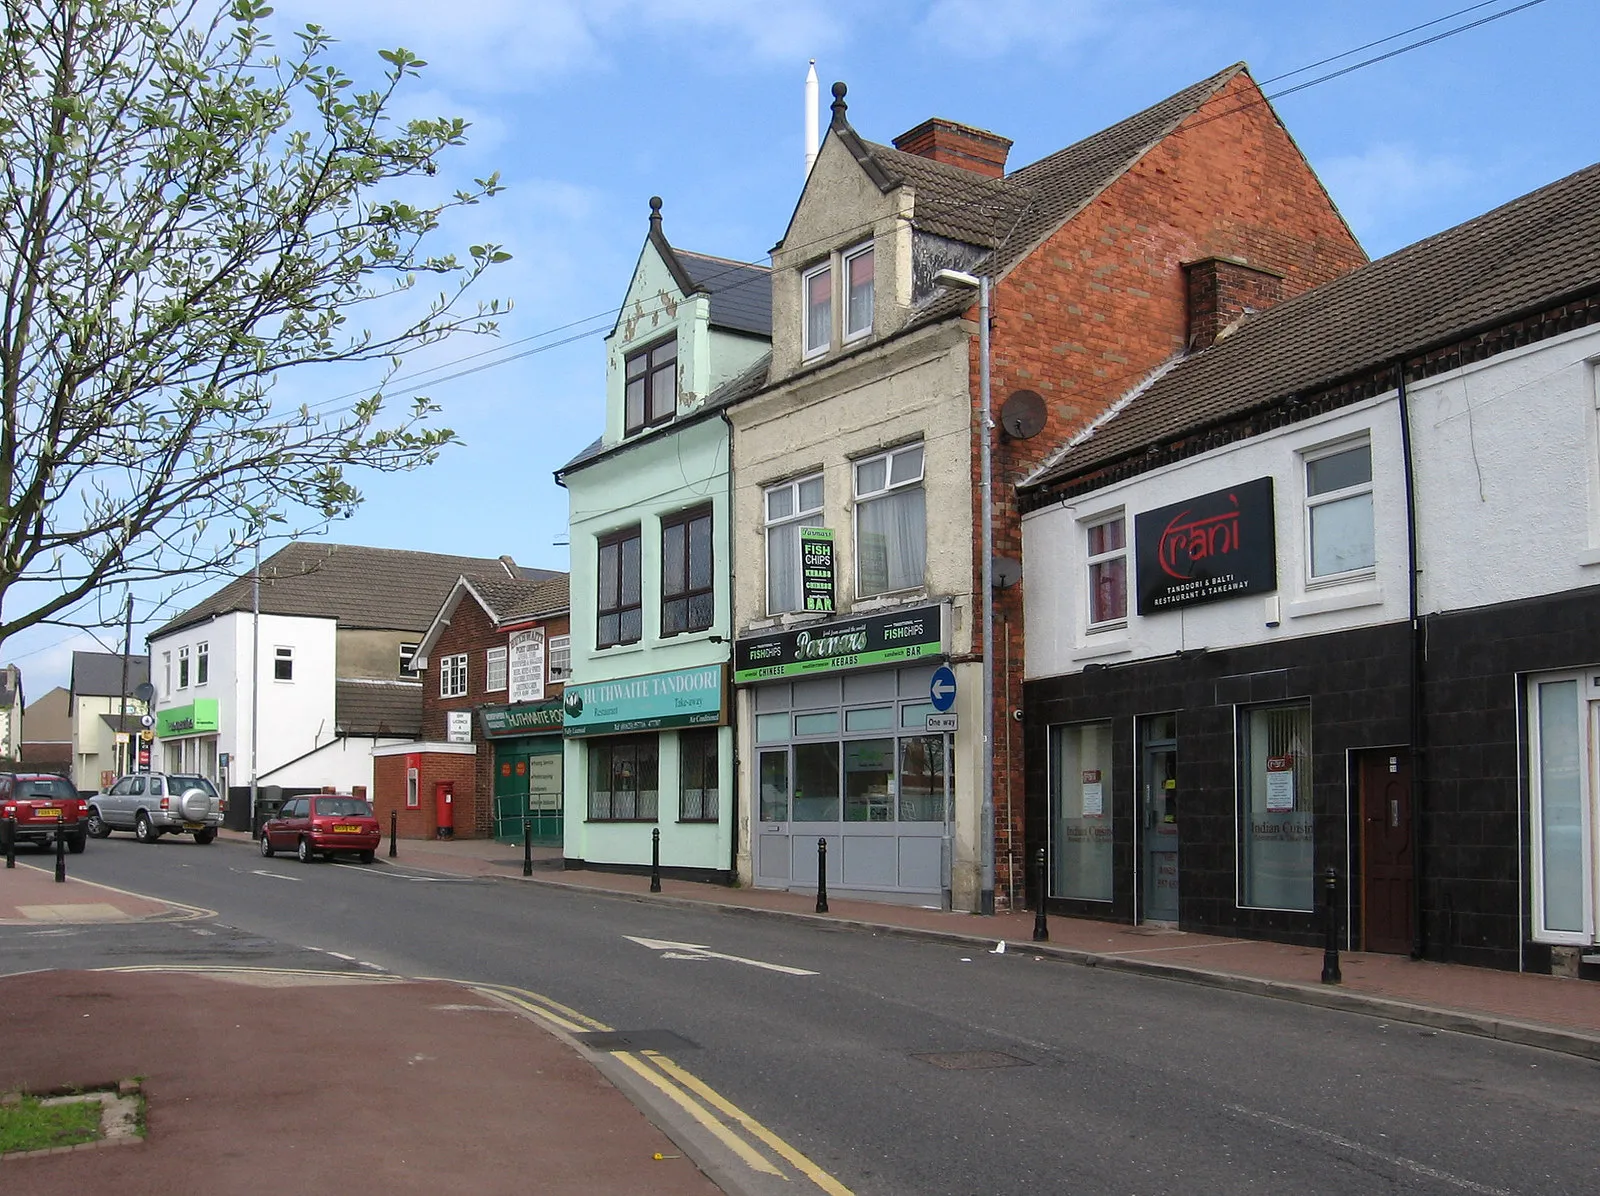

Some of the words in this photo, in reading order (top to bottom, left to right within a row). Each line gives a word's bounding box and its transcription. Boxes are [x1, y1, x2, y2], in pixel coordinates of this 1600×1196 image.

[804, 544, 831, 556] FISH
[805, 554, 831, 566] CHIPS
[805, 569, 831, 578] KEBABS
[805, 582, 832, 590] CHINESE
[1167, 581, 1202, 594] TANDOORI
[1212, 574, 1234, 585] BALTI
[1154, 591, 1199, 606] RESTAURANT
[1201, 588, 1207, 596] &
[1208, 580, 1249, 595] TAKEAWAY
[807, 598, 832, 611] BAR
[906, 646, 921, 657] BAR
[831, 655, 858, 667] KEBABS
[758, 665, 785, 677] CHINESE
[584, 680, 650, 704] HUTHWAITE
[652, 670, 719, 696] TANDOORI
[509, 711, 550, 727] HUTHWAITE
[928, 718, 941, 727] One
[943, 719, 956, 728] way
[1251, 821, 1280, 834] Indian
